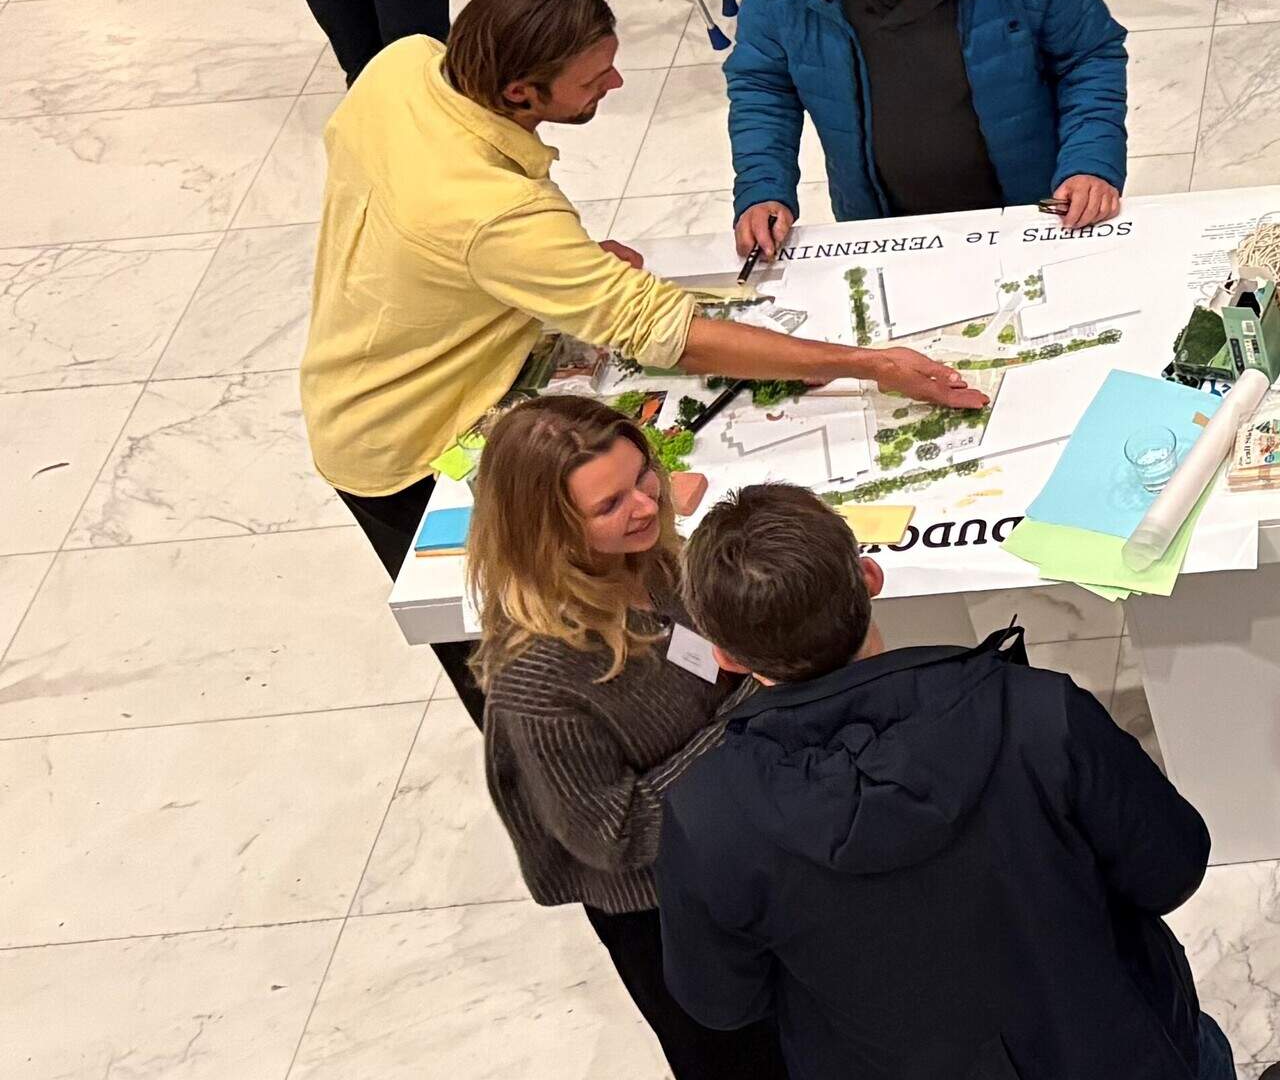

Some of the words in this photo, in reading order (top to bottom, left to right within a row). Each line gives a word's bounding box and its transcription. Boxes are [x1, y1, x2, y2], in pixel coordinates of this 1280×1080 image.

[965, 230, 1001, 246] 1e
[1022, 221, 1133, 243] SCHETS
[859, 516, 1026, 554] DUDO
